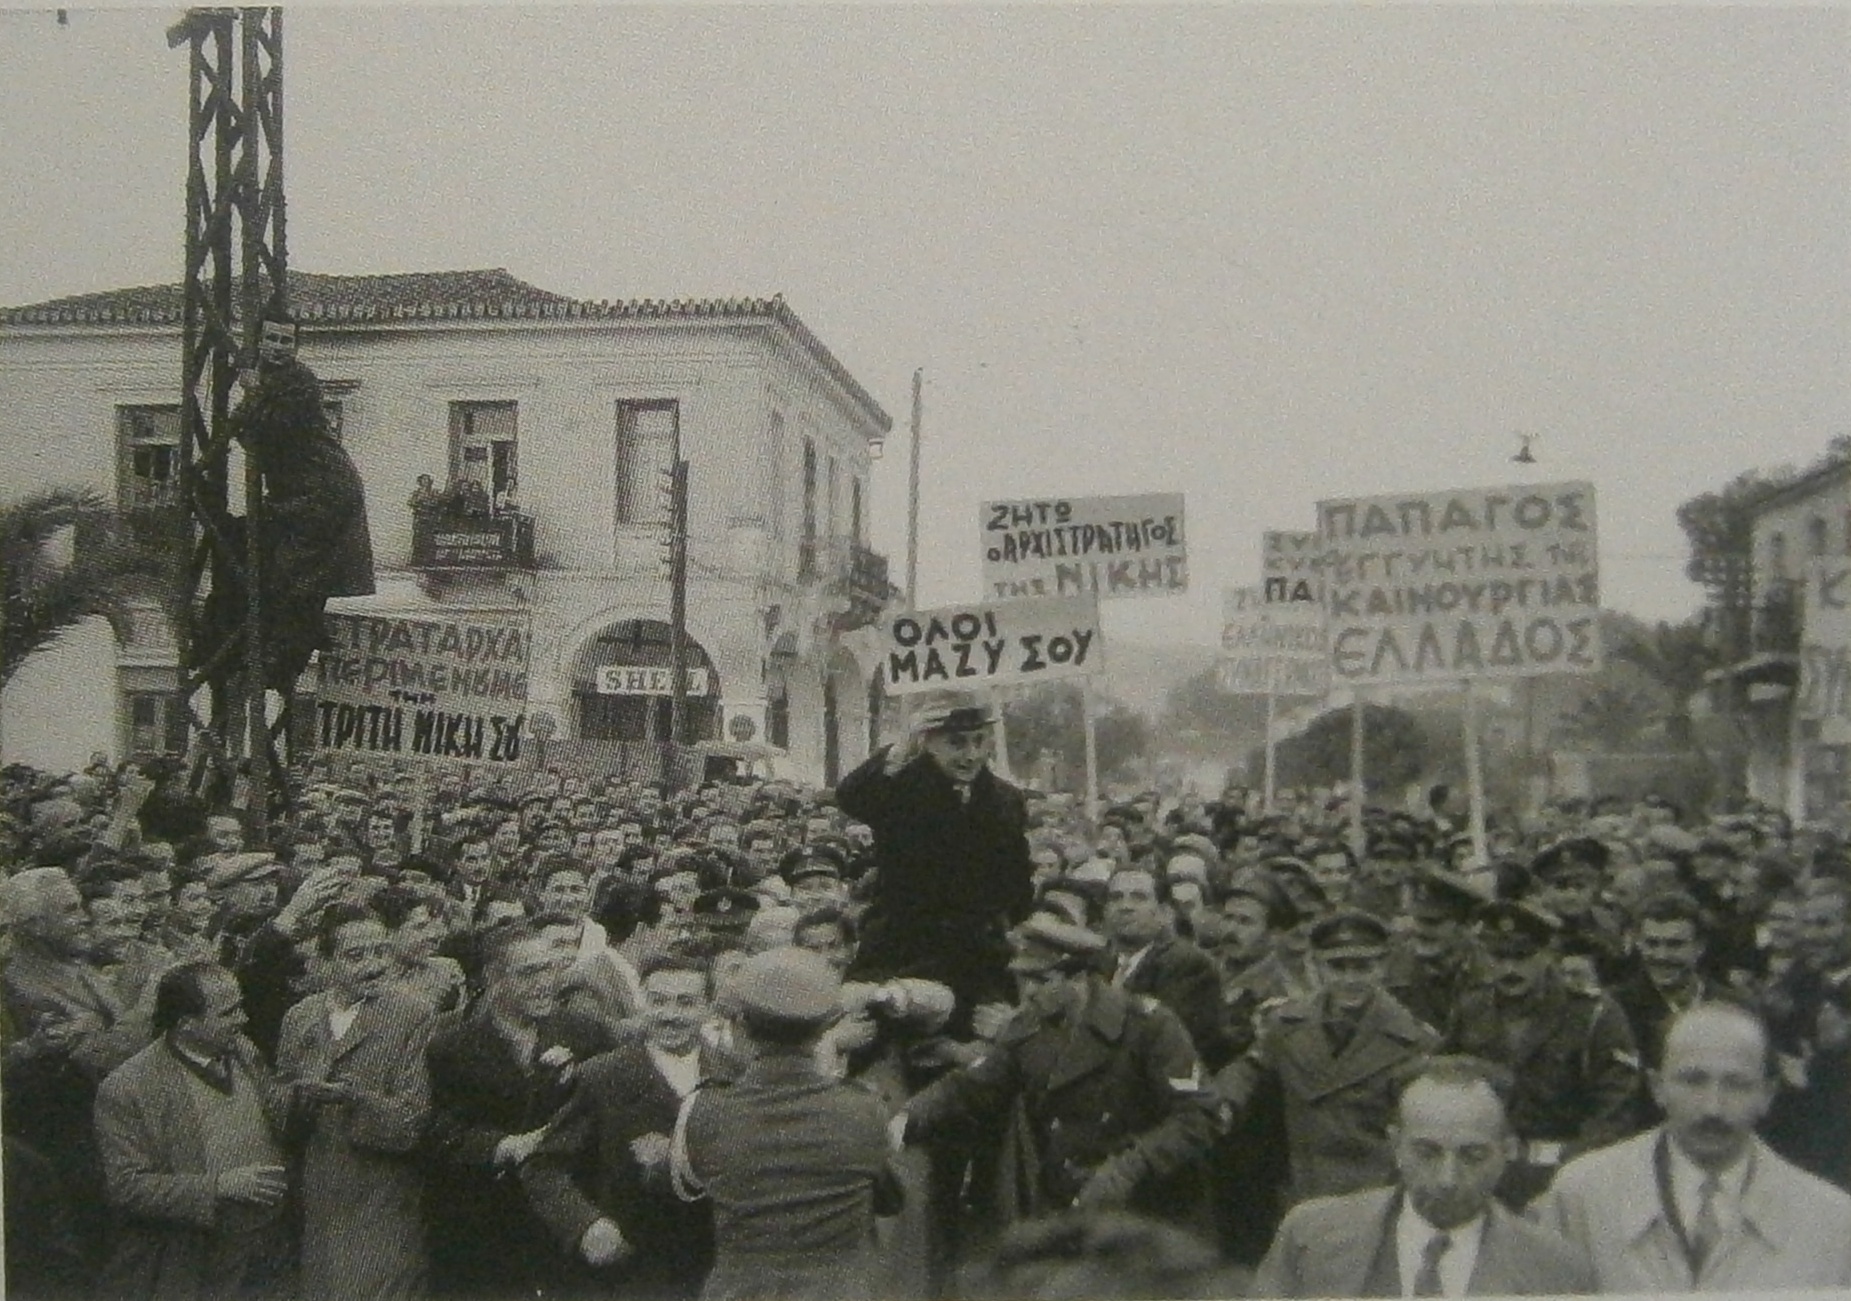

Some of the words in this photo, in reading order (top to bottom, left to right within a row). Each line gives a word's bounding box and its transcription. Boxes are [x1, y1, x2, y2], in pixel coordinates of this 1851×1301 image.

[1324, 492, 1588, 539] ΠΑΠΑΓΟΣ
[1055, 555, 1184, 593] ΝΙΚΗΣ
[893, 611, 997, 647] ΟΛΟΙ
[1333, 617, 1594, 678] ΕΛΛΑΔΟΣ
[889, 639, 1005, 684] ΜΑΖΥ
[1020, 629, 1092, 673] ΣΟΥ
[605, 669, 704, 692] SHEL
[318, 701, 403, 752] ΤΡΙΤΗ
[413, 709, 483, 758] ΝΙΚΗ
